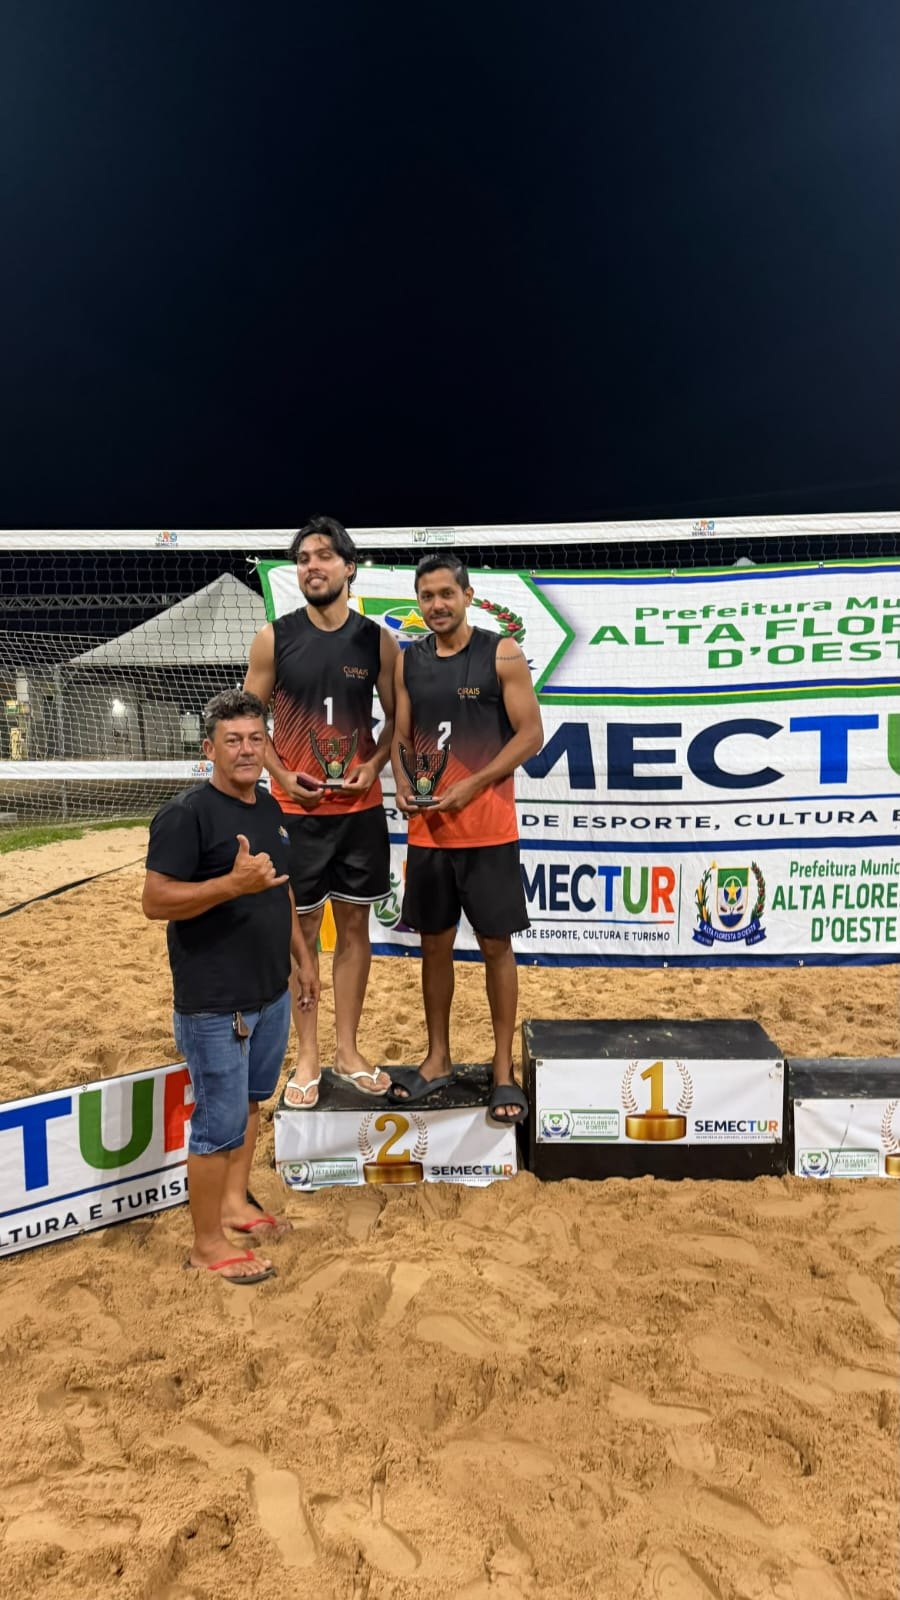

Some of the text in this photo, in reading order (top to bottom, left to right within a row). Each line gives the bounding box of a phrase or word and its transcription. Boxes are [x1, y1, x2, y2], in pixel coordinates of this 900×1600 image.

[635, 600, 832, 620] Prefeitura
[588, 623, 746, 646] ALTA
[323, 697, 334, 726] 1
[437, 721, 452, 750] 2
[521, 813, 560, 828] DE
[572, 815, 721, 832] ESPORTE,
[734, 809, 878, 827] CULTURA
[790, 860, 856, 878] Prefeitura
[520, 863, 676, 915] MECTUR
[771, 882, 899, 911] ALTA FLORE
[526, 929, 537, 939] DE
[540, 929, 581, 941] ESPORTE,
[583, 930, 621, 940] CULTURA
[624, 932, 629, 940] E
[633, 931, 670, 942] TURISMO
[703, 924, 714, 937] ALTA
[714, 932, 736, 940] FLORESTA
[811, 916, 897, 943] D'OESTE
[640, 1061, 668, 1117] 1
[694, 1119, 778, 1133] SEMECTUR
[375, 1113, 410, 1164] 2
[431, 1164, 513, 1176] SEMECTUR
[89, 1203, 103, 1220] E
